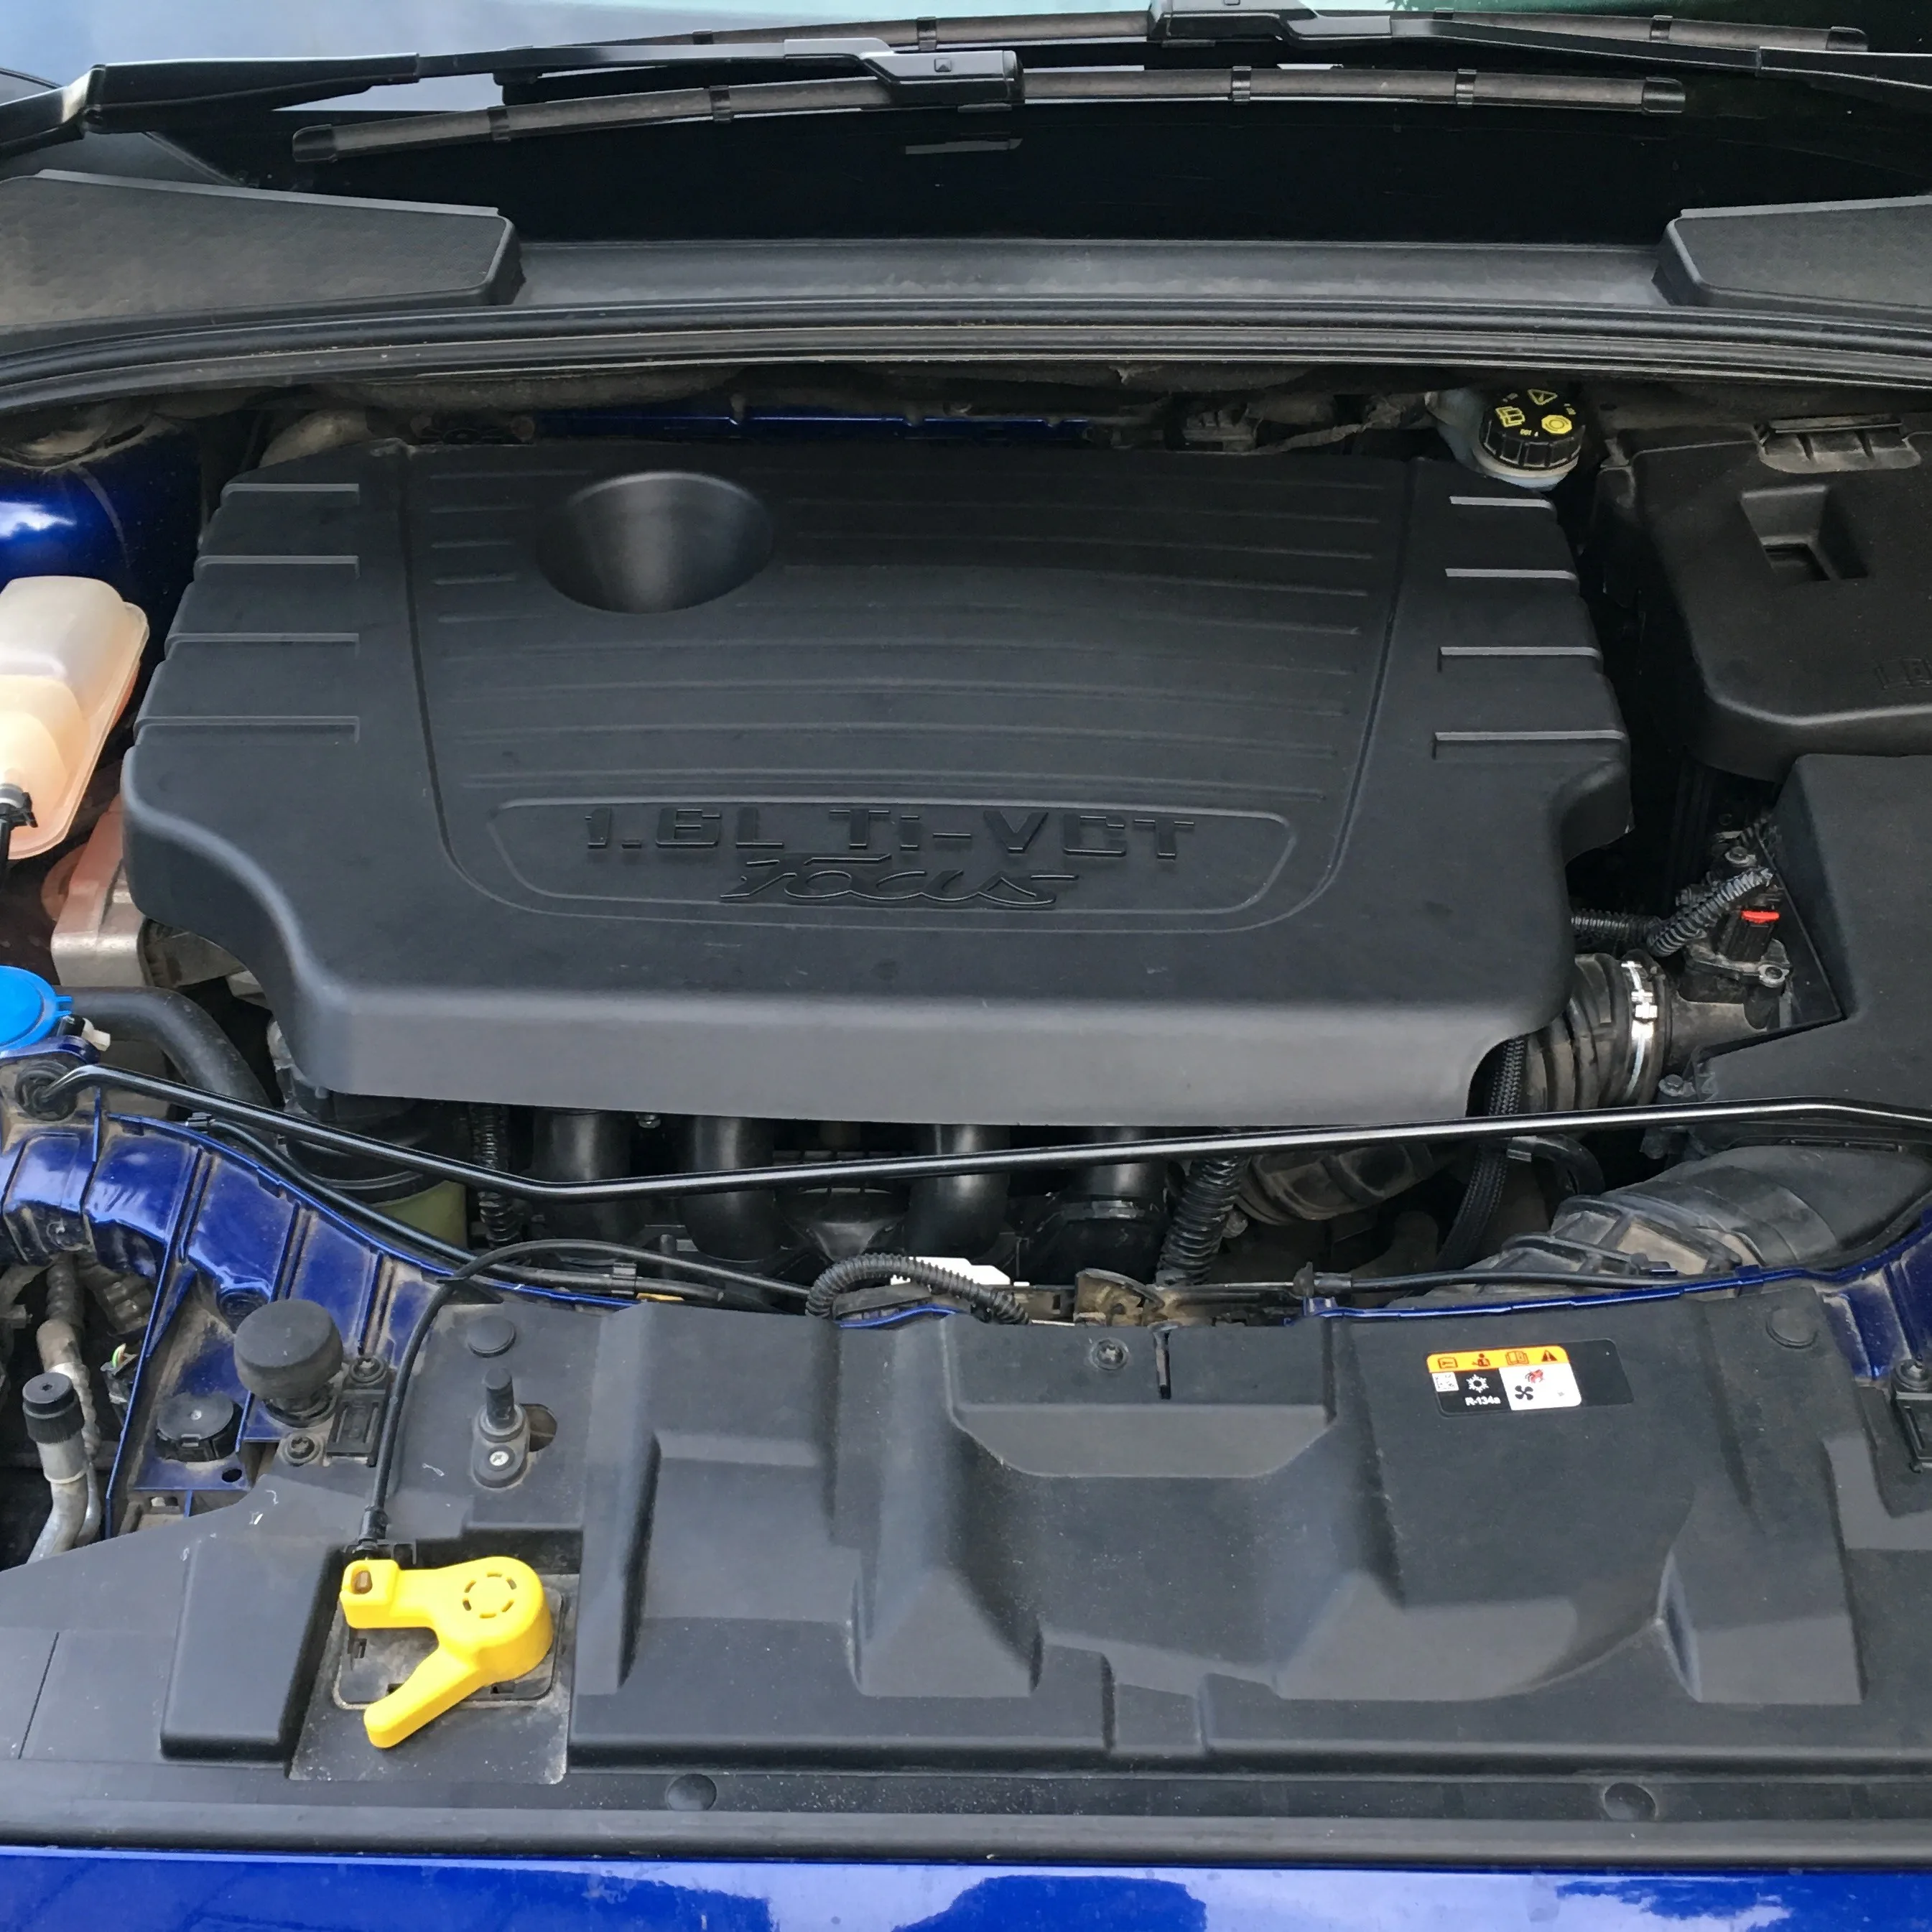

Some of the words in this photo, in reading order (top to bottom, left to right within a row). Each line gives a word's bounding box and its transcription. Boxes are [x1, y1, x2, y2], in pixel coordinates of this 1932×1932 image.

[585, 807, 784, 849] 1.6L
[829, 808, 1194, 860] Ti-VCT
[1465, 1395, 1501, 1406] R-134a
